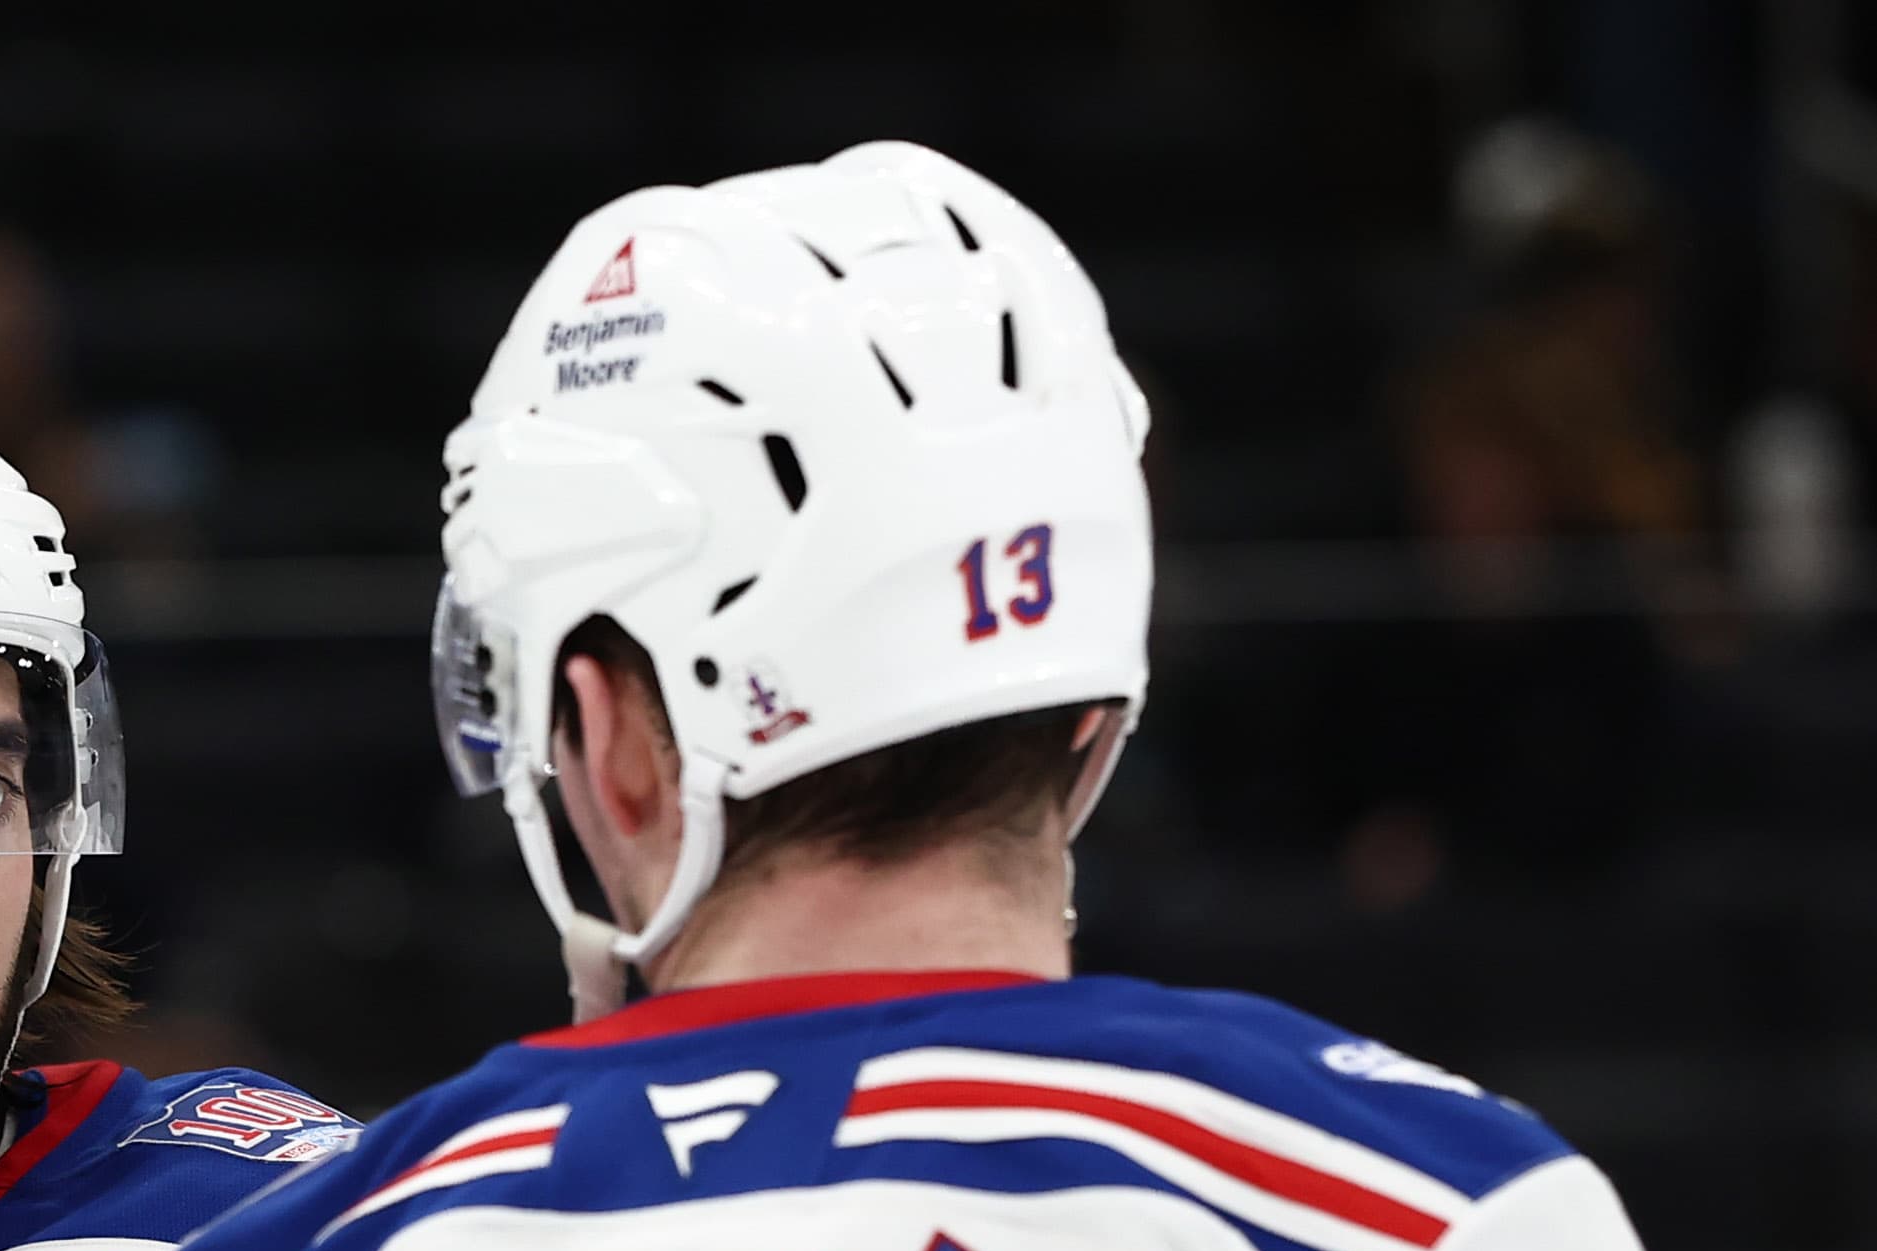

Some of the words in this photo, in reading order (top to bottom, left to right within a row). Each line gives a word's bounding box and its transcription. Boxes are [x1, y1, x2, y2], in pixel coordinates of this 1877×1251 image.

[544, 302, 665, 355] Benjamin
[555, 357, 639, 392] Moore
[957, 523, 1054, 643] 13
[167, 1087, 343, 1150] 100
